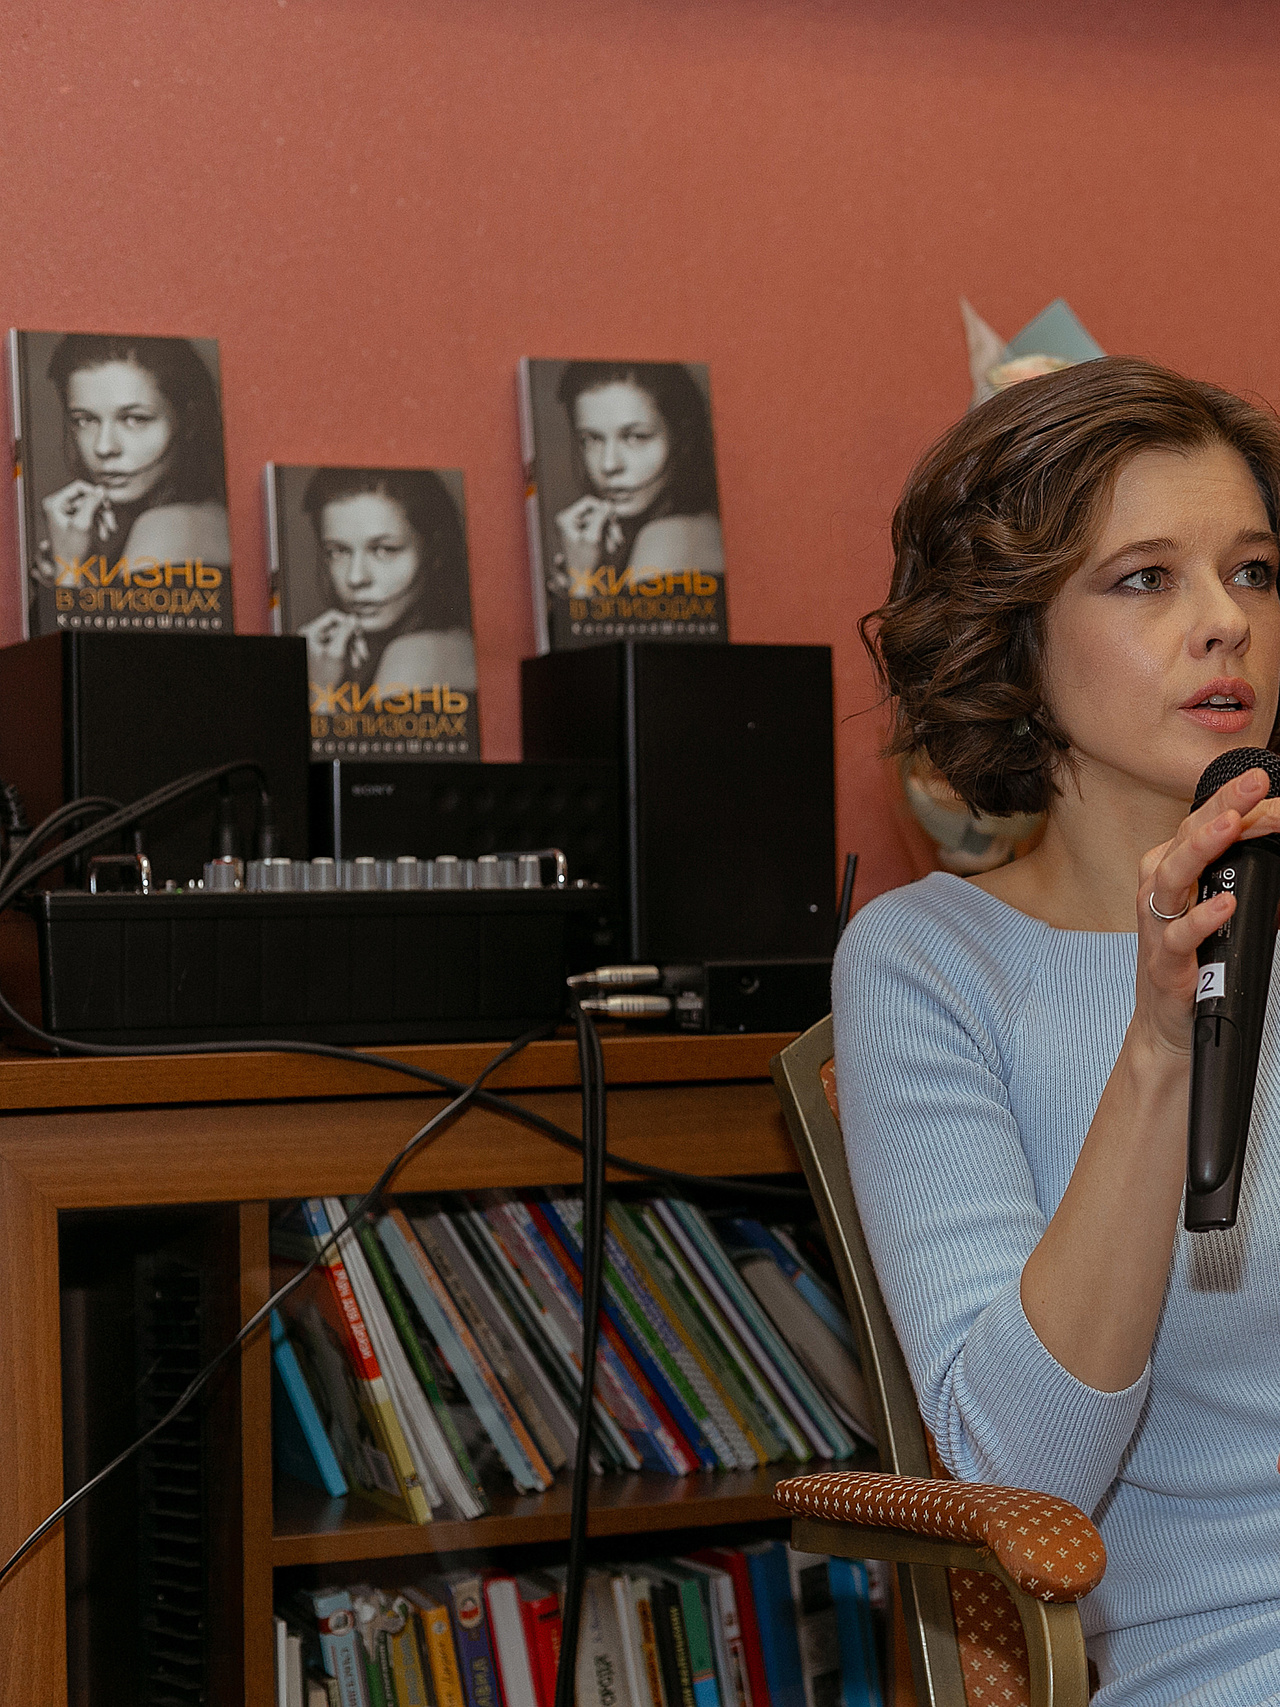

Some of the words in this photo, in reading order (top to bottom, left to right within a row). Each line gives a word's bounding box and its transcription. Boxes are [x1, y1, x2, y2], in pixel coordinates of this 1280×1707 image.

[55, 555, 222, 589] ЖИЗНЬ
[568, 565, 718, 597] ЖИЗНЬ
[55, 588, 75, 612] В
[78, 587, 221, 615] ЭПИЗОДАХ
[309, 681, 469, 714] ЖИЗНЬ
[310, 713, 329, 738] В
[332, 712, 467, 739] ЭПИЗОДАХ
[1200, 971, 1215, 993] 2
